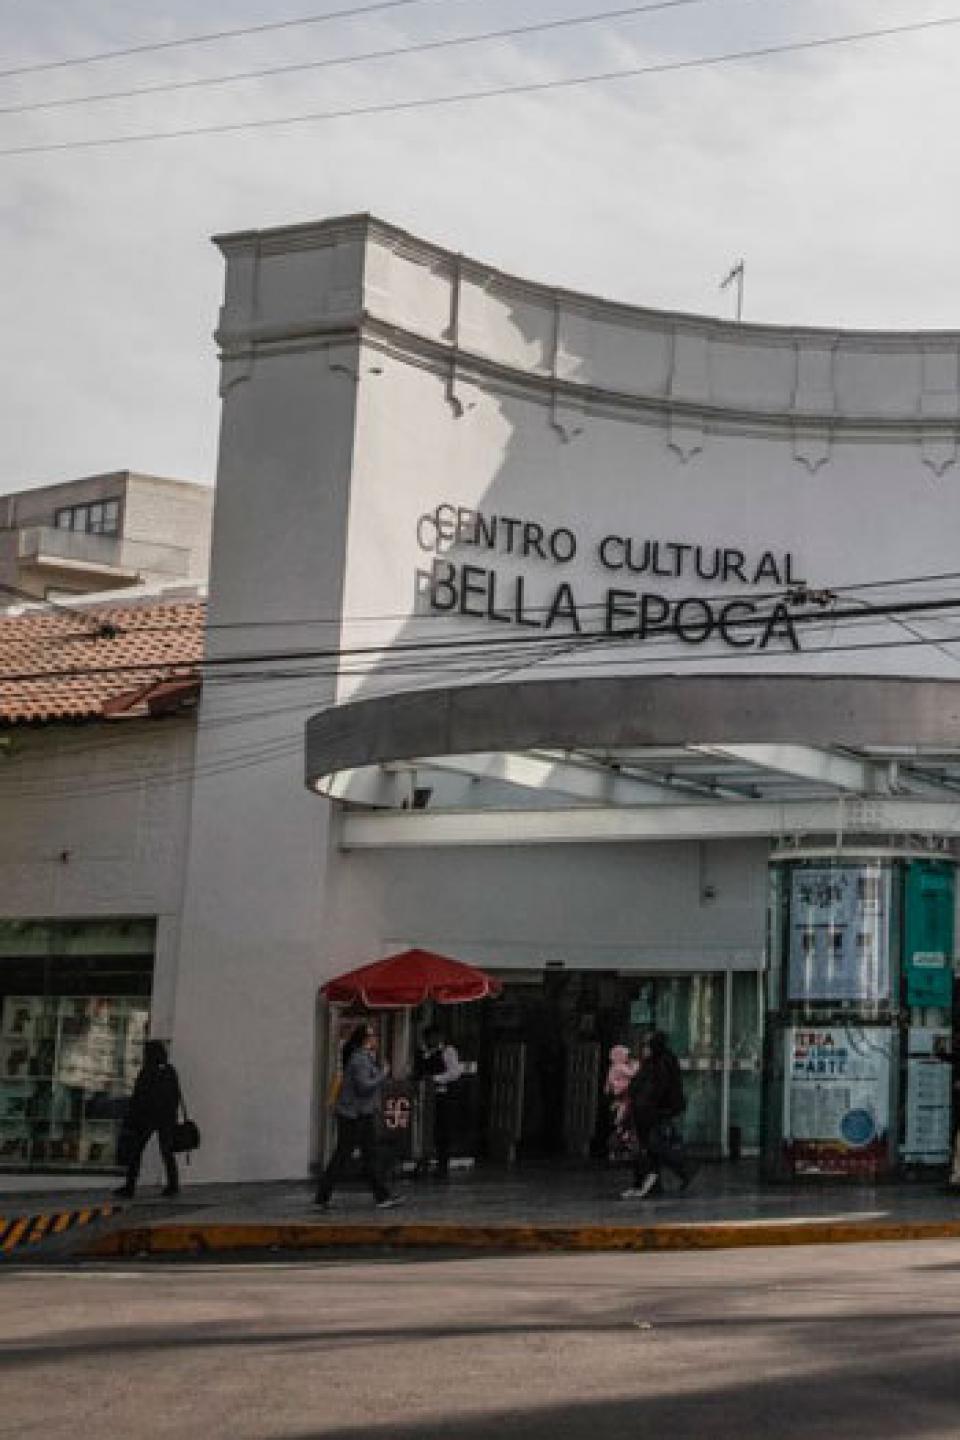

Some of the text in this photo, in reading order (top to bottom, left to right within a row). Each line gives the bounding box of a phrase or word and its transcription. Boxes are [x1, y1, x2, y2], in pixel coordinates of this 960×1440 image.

[434, 503, 807, 585] CENTRO CULTURAL
[430, 558, 800, 652] BELLA EPOCA
